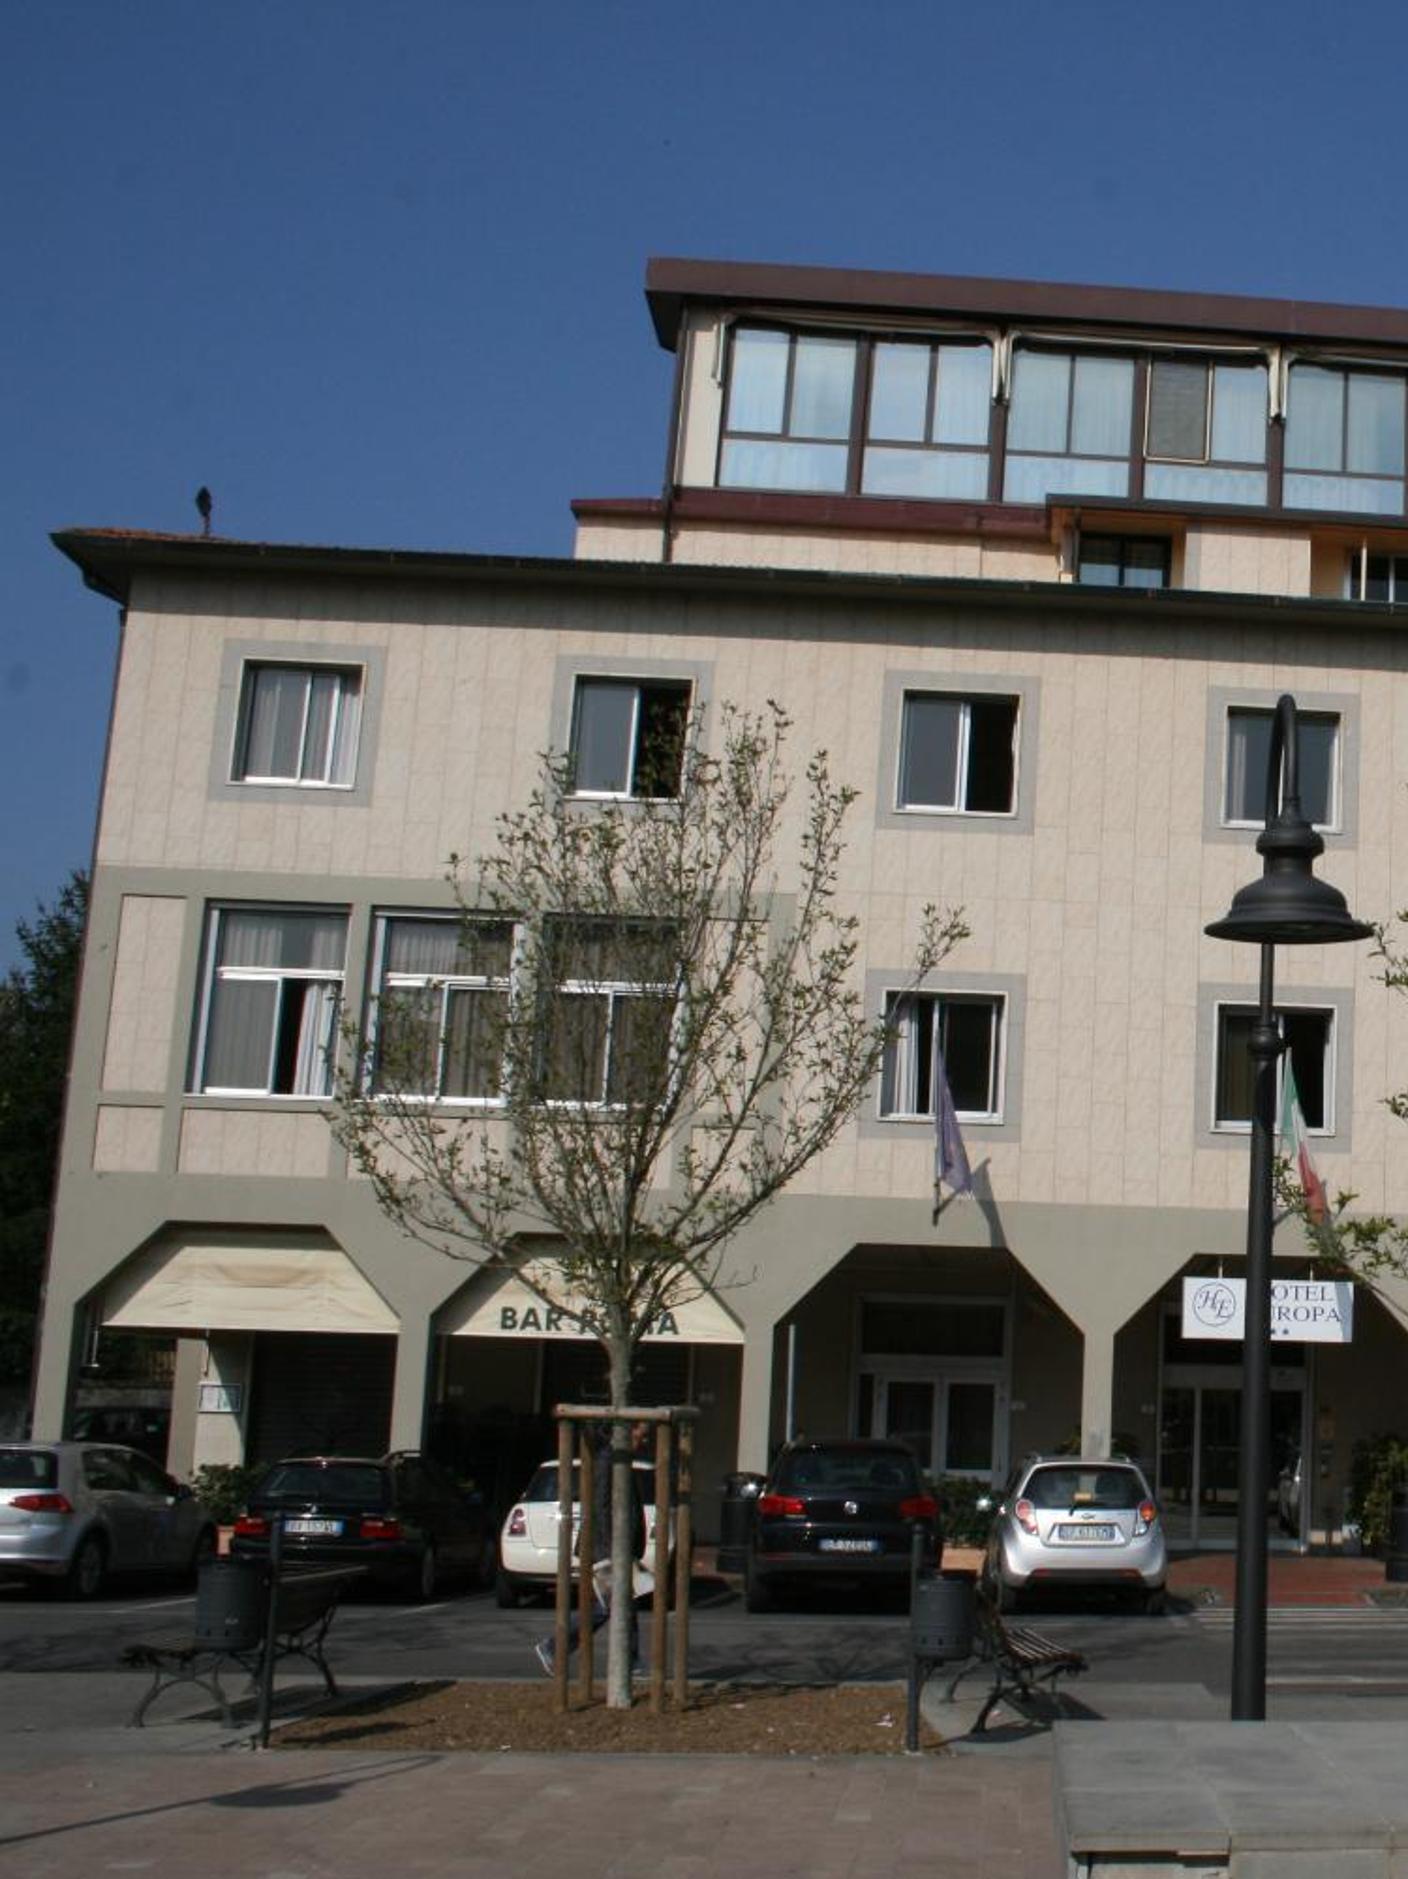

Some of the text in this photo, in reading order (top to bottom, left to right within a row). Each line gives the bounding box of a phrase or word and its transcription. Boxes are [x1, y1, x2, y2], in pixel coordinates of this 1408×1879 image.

[1272, 1285, 1334, 1301] OTEL
[501, 1306, 562, 1332] BAR
[1271, 1305, 1342, 1322] ROPA
